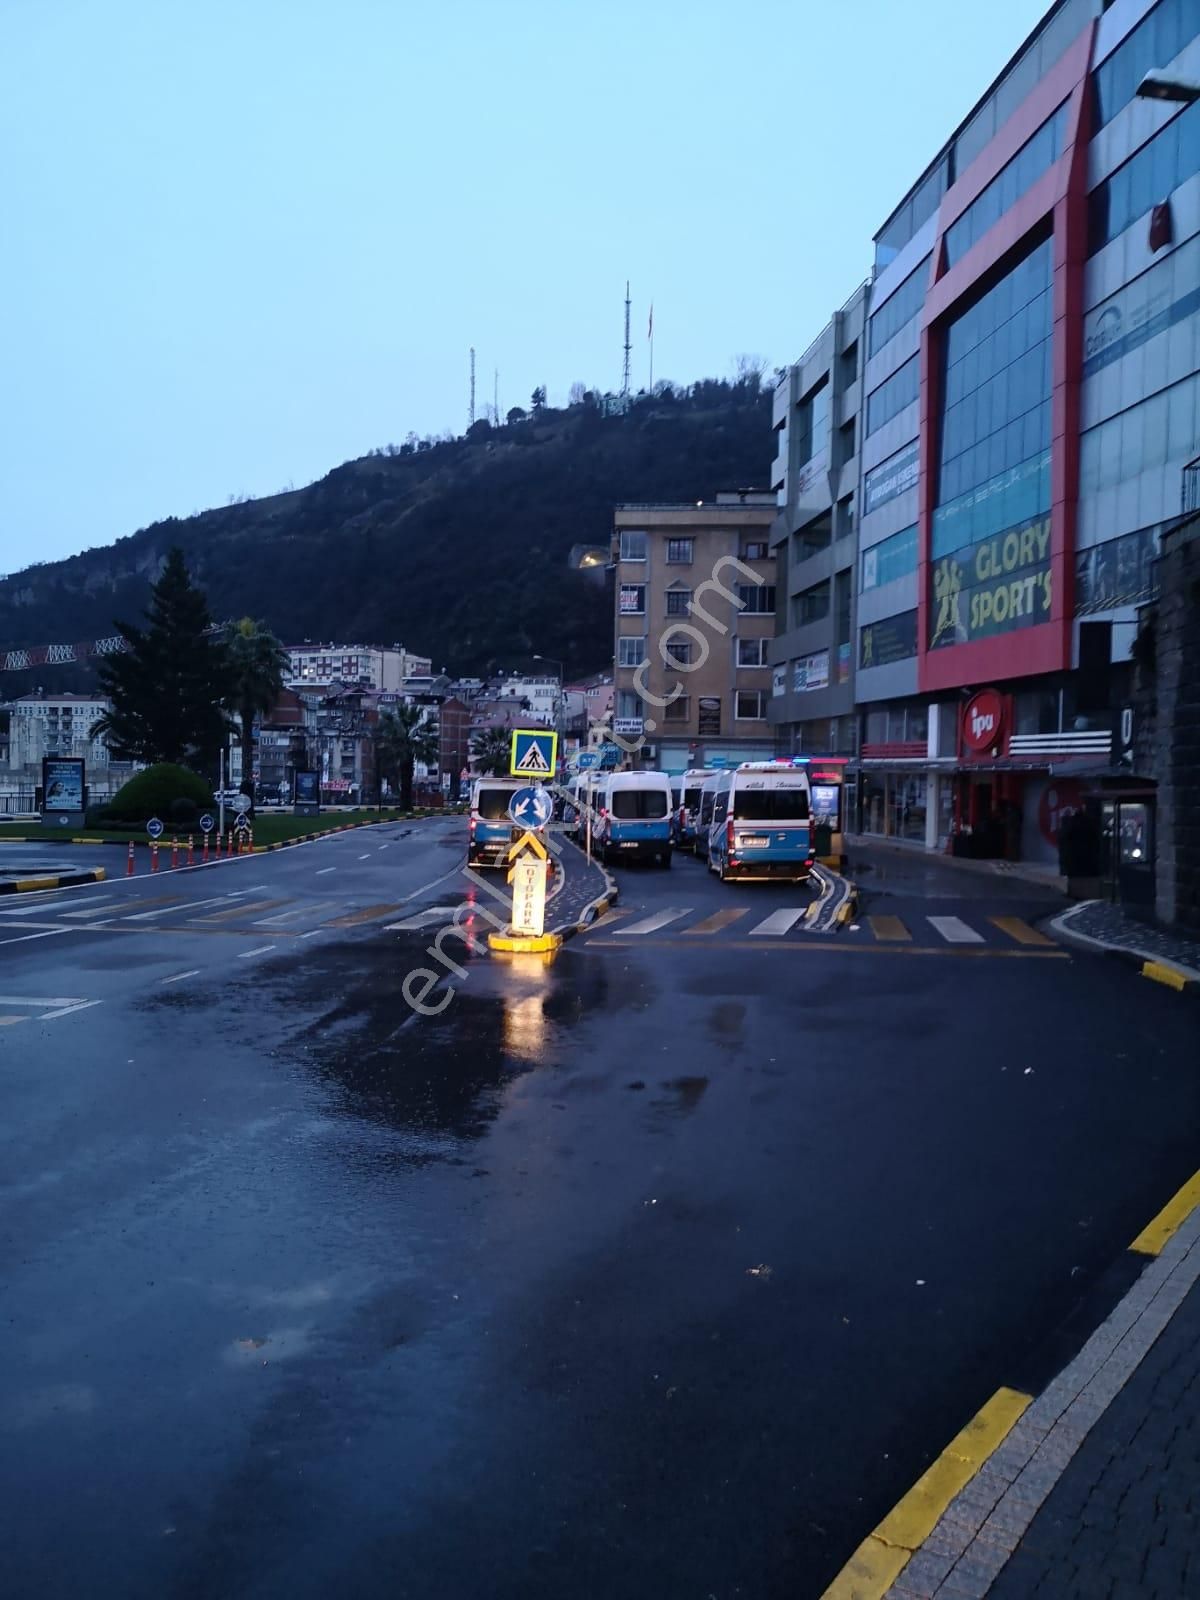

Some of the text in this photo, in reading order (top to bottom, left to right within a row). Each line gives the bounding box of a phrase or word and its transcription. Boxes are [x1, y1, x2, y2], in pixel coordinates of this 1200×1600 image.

[976, 518, 1051, 580] GLORY
[971, 568, 1051, 629] SPORT'S
[523, 867, 535, 926] OTOPARK
